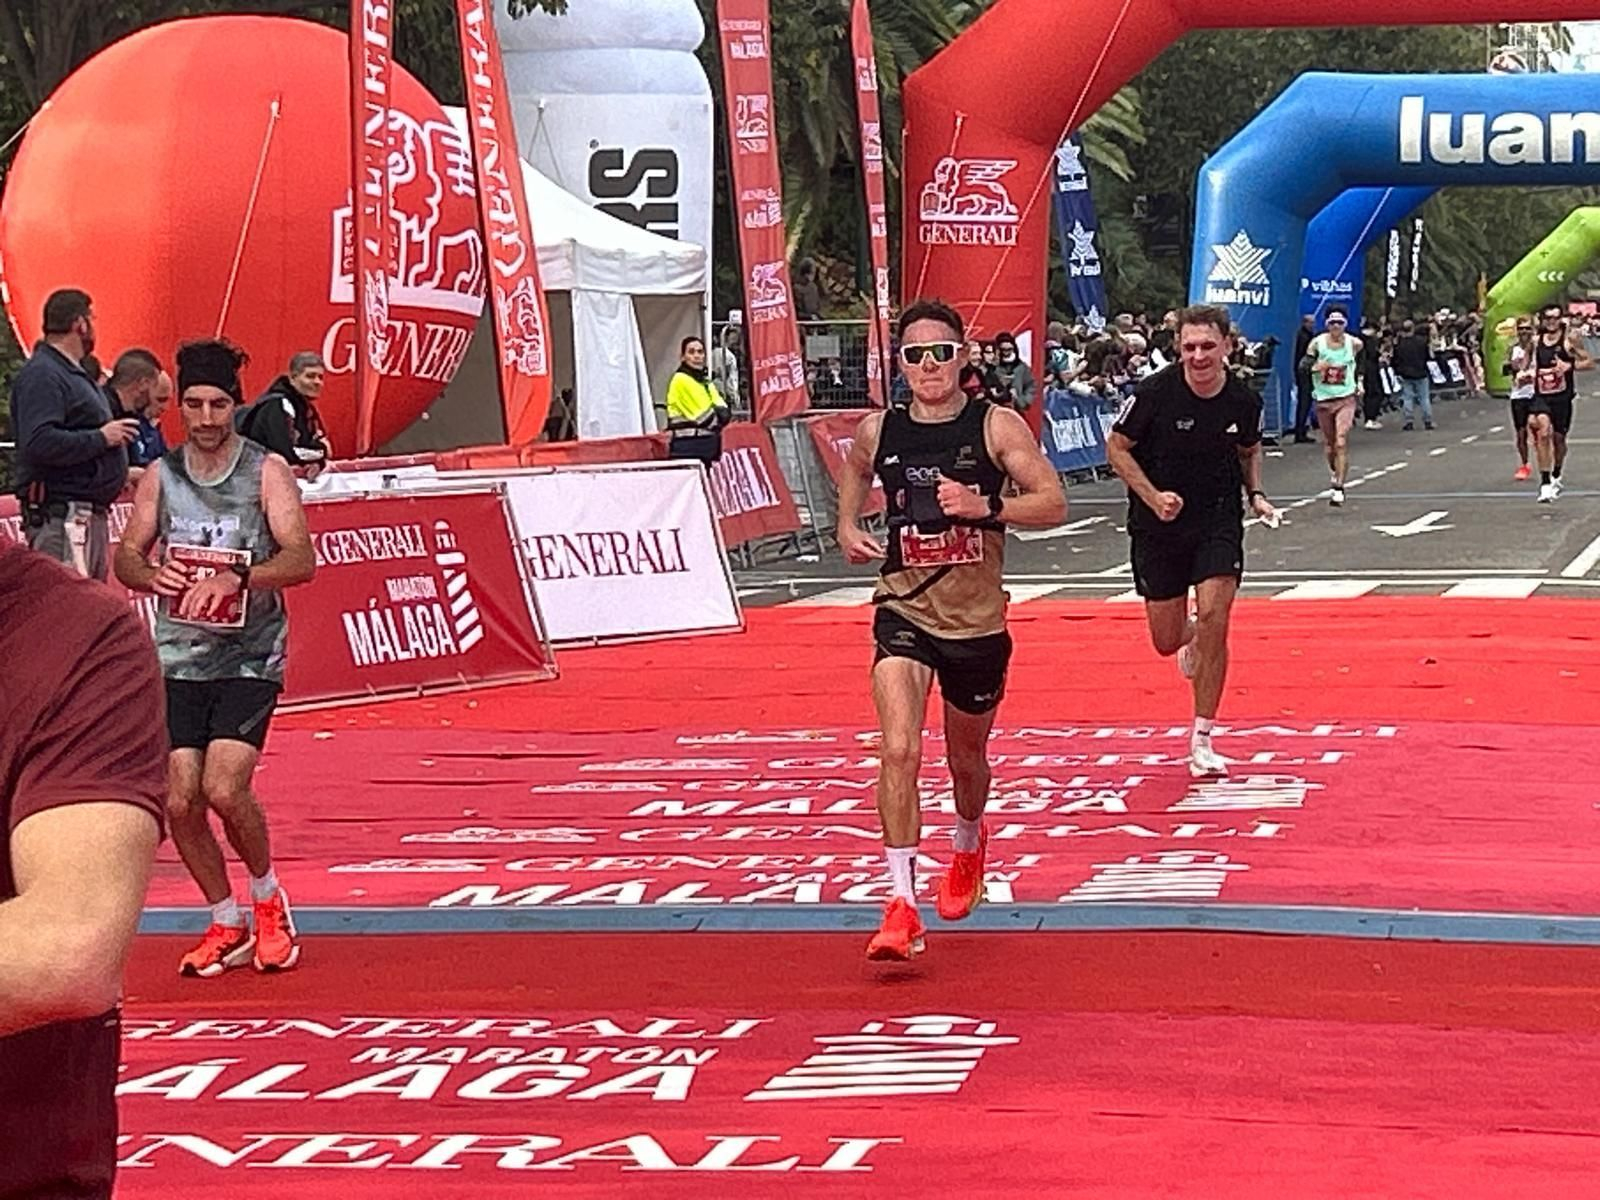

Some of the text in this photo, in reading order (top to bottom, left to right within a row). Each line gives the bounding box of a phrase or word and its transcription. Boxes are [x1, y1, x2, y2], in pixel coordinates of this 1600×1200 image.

[1400, 95, 1600, 165] luan
[919, 222, 1019, 247] GENERALI
[1205, 283, 1270, 306] luanvi
[322, 317, 473, 383] GNER
[320, 524, 429, 566] GENERALI
[341, 597, 459, 667] MÁLAGA
[683, 775, 1157, 791] GENEALI
[740, 872, 1022, 884] MARATN
[349, 1046, 720, 1064] MARATÓN
[114, 1056, 698, 1101] ÁLAGA
